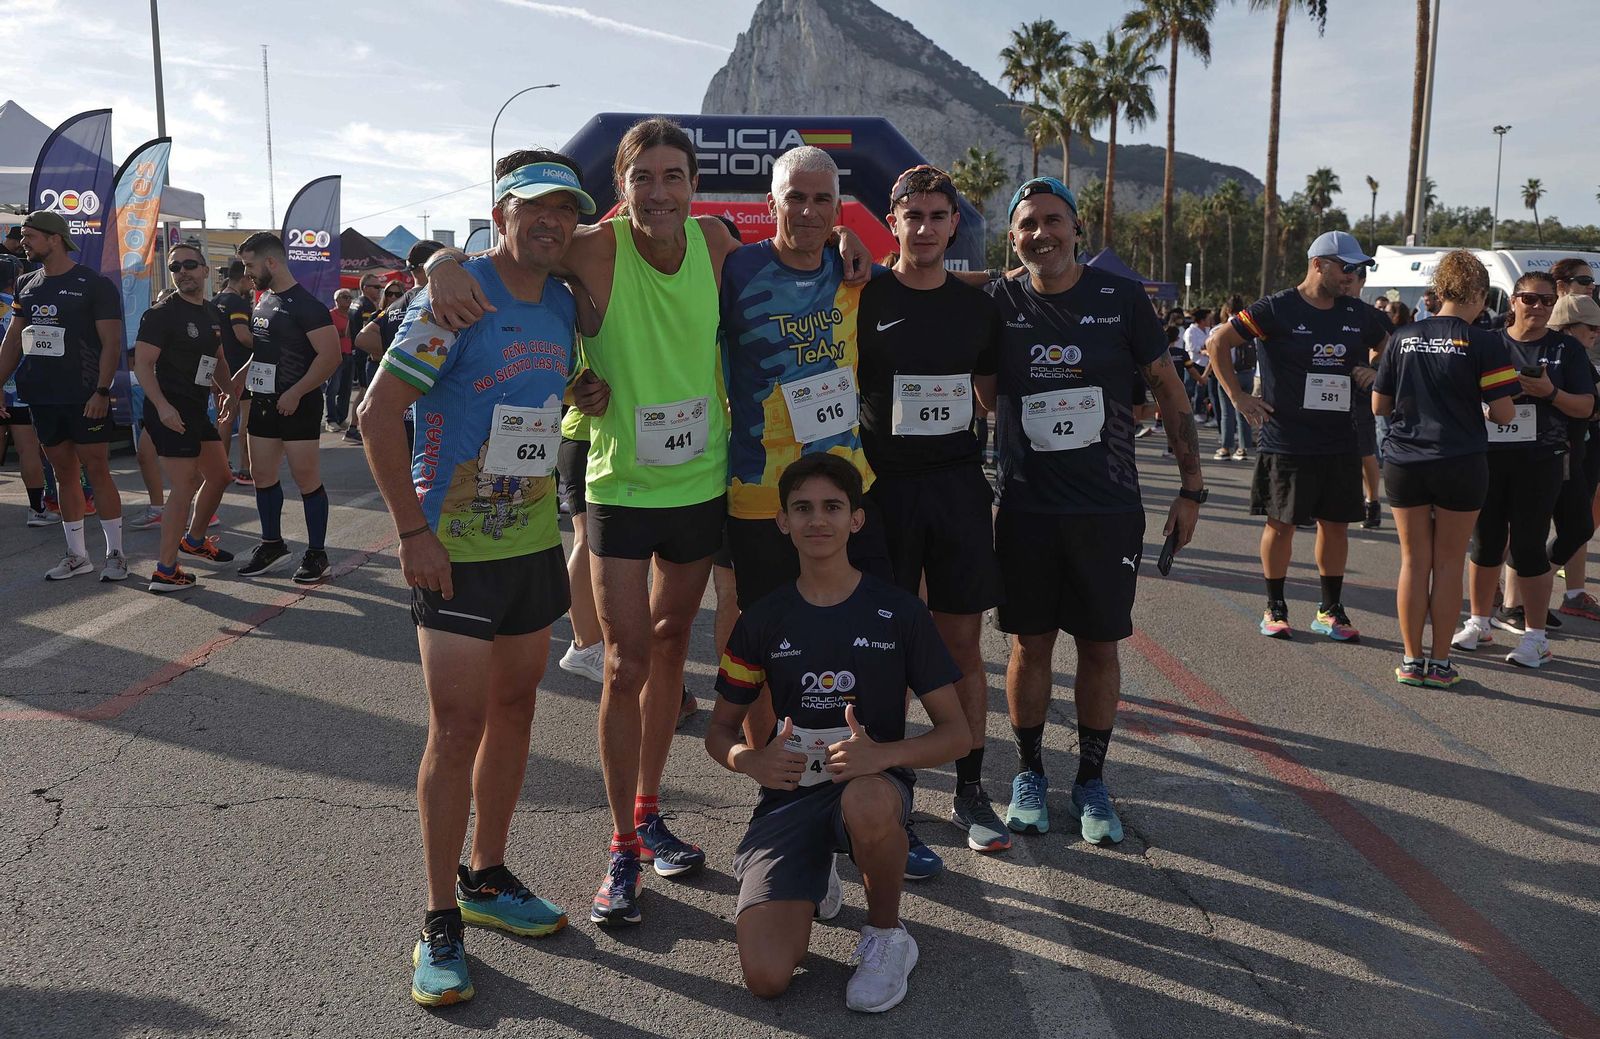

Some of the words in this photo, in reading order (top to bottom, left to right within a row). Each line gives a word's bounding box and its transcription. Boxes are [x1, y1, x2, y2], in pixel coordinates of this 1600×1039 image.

[680, 128, 806, 149] LICIA
[737, 213, 778, 224] Santa
[288, 229, 331, 248] 200
[31, 304, 58, 317] 200
[1097, 314, 1121, 325] mupol
[35, 340, 53, 349] 602
[1400, 336, 1454, 346] POLICIA
[1030, 344, 1082, 365] 200
[1312, 343, 1347, 357] 200
[1400, 345, 1467, 356] NACIONAL
[474, 375, 495, 394] NO
[494, 357, 532, 384] SIENTO
[1030, 366, 1072, 374] POLICIA
[1320, 393, 1339, 402] 581
[816, 403, 845, 423] 616
[919, 406, 951, 421] 615
[1052, 420, 1075, 436] 42
[1497, 424, 1519, 433] 579
[664, 431, 692, 451] 441
[516, 444, 546, 460] 624
[870, 641, 896, 651] mupol
[770, 649, 802, 659] Santander
[801, 670, 856, 694] 200
[801, 696, 845, 704] POLICIA
